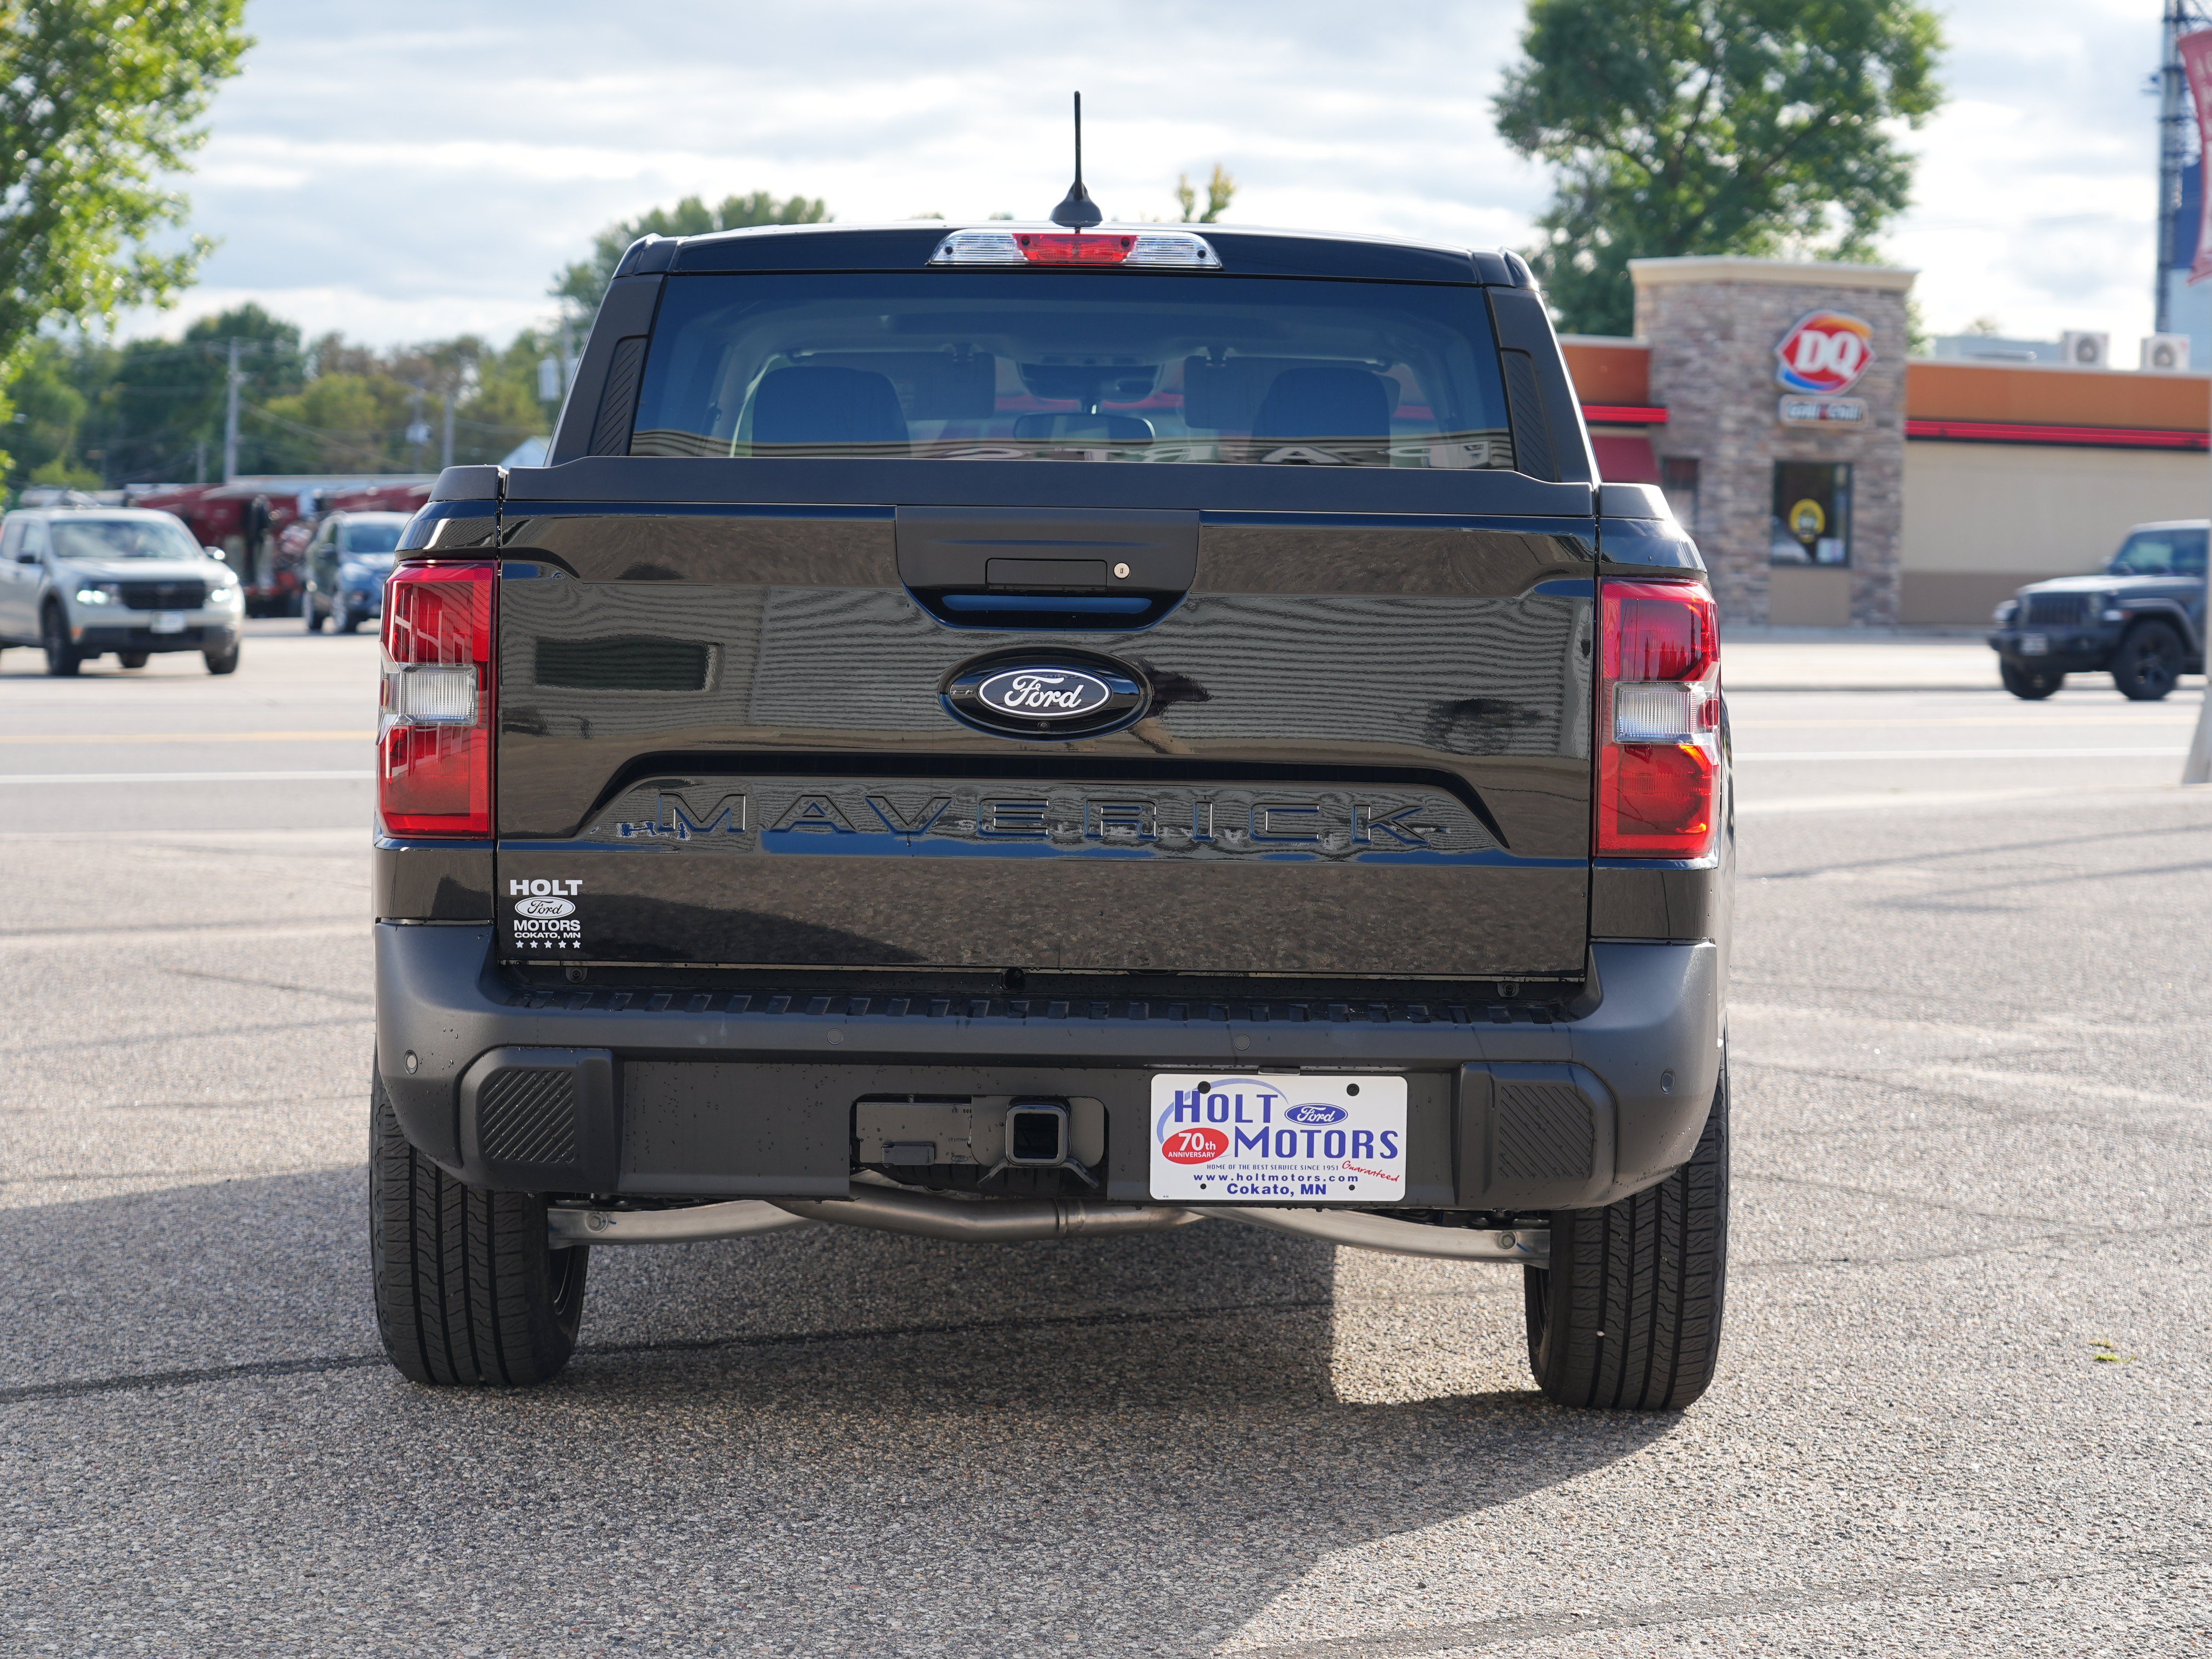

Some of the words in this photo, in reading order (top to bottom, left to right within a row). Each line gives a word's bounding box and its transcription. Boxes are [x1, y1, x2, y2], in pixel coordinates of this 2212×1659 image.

[1796, 330, 1860, 379] DQ
[1004, 675, 1084, 708] Ford
[657, 790, 1431, 846] MAVERICK
[510, 879, 583, 896] HOLT
[527, 900, 563, 914] Ford
[514, 920, 581, 932] MOTORS
[1175, 1090, 1278, 1123] HOLT
[1297, 1106, 1336, 1122] Ford
[1178, 1132, 1216, 1151] 70th
[1234, 1126, 1399, 1159] MOTORS
[1193, 1173, 1359, 1182] www.holtmotors.com
[1342, 1161, 1400, 1182] Guaranteed
[1227, 1183, 1294, 1197] Cokato,
[1300, 1184, 1327, 1195] MN
